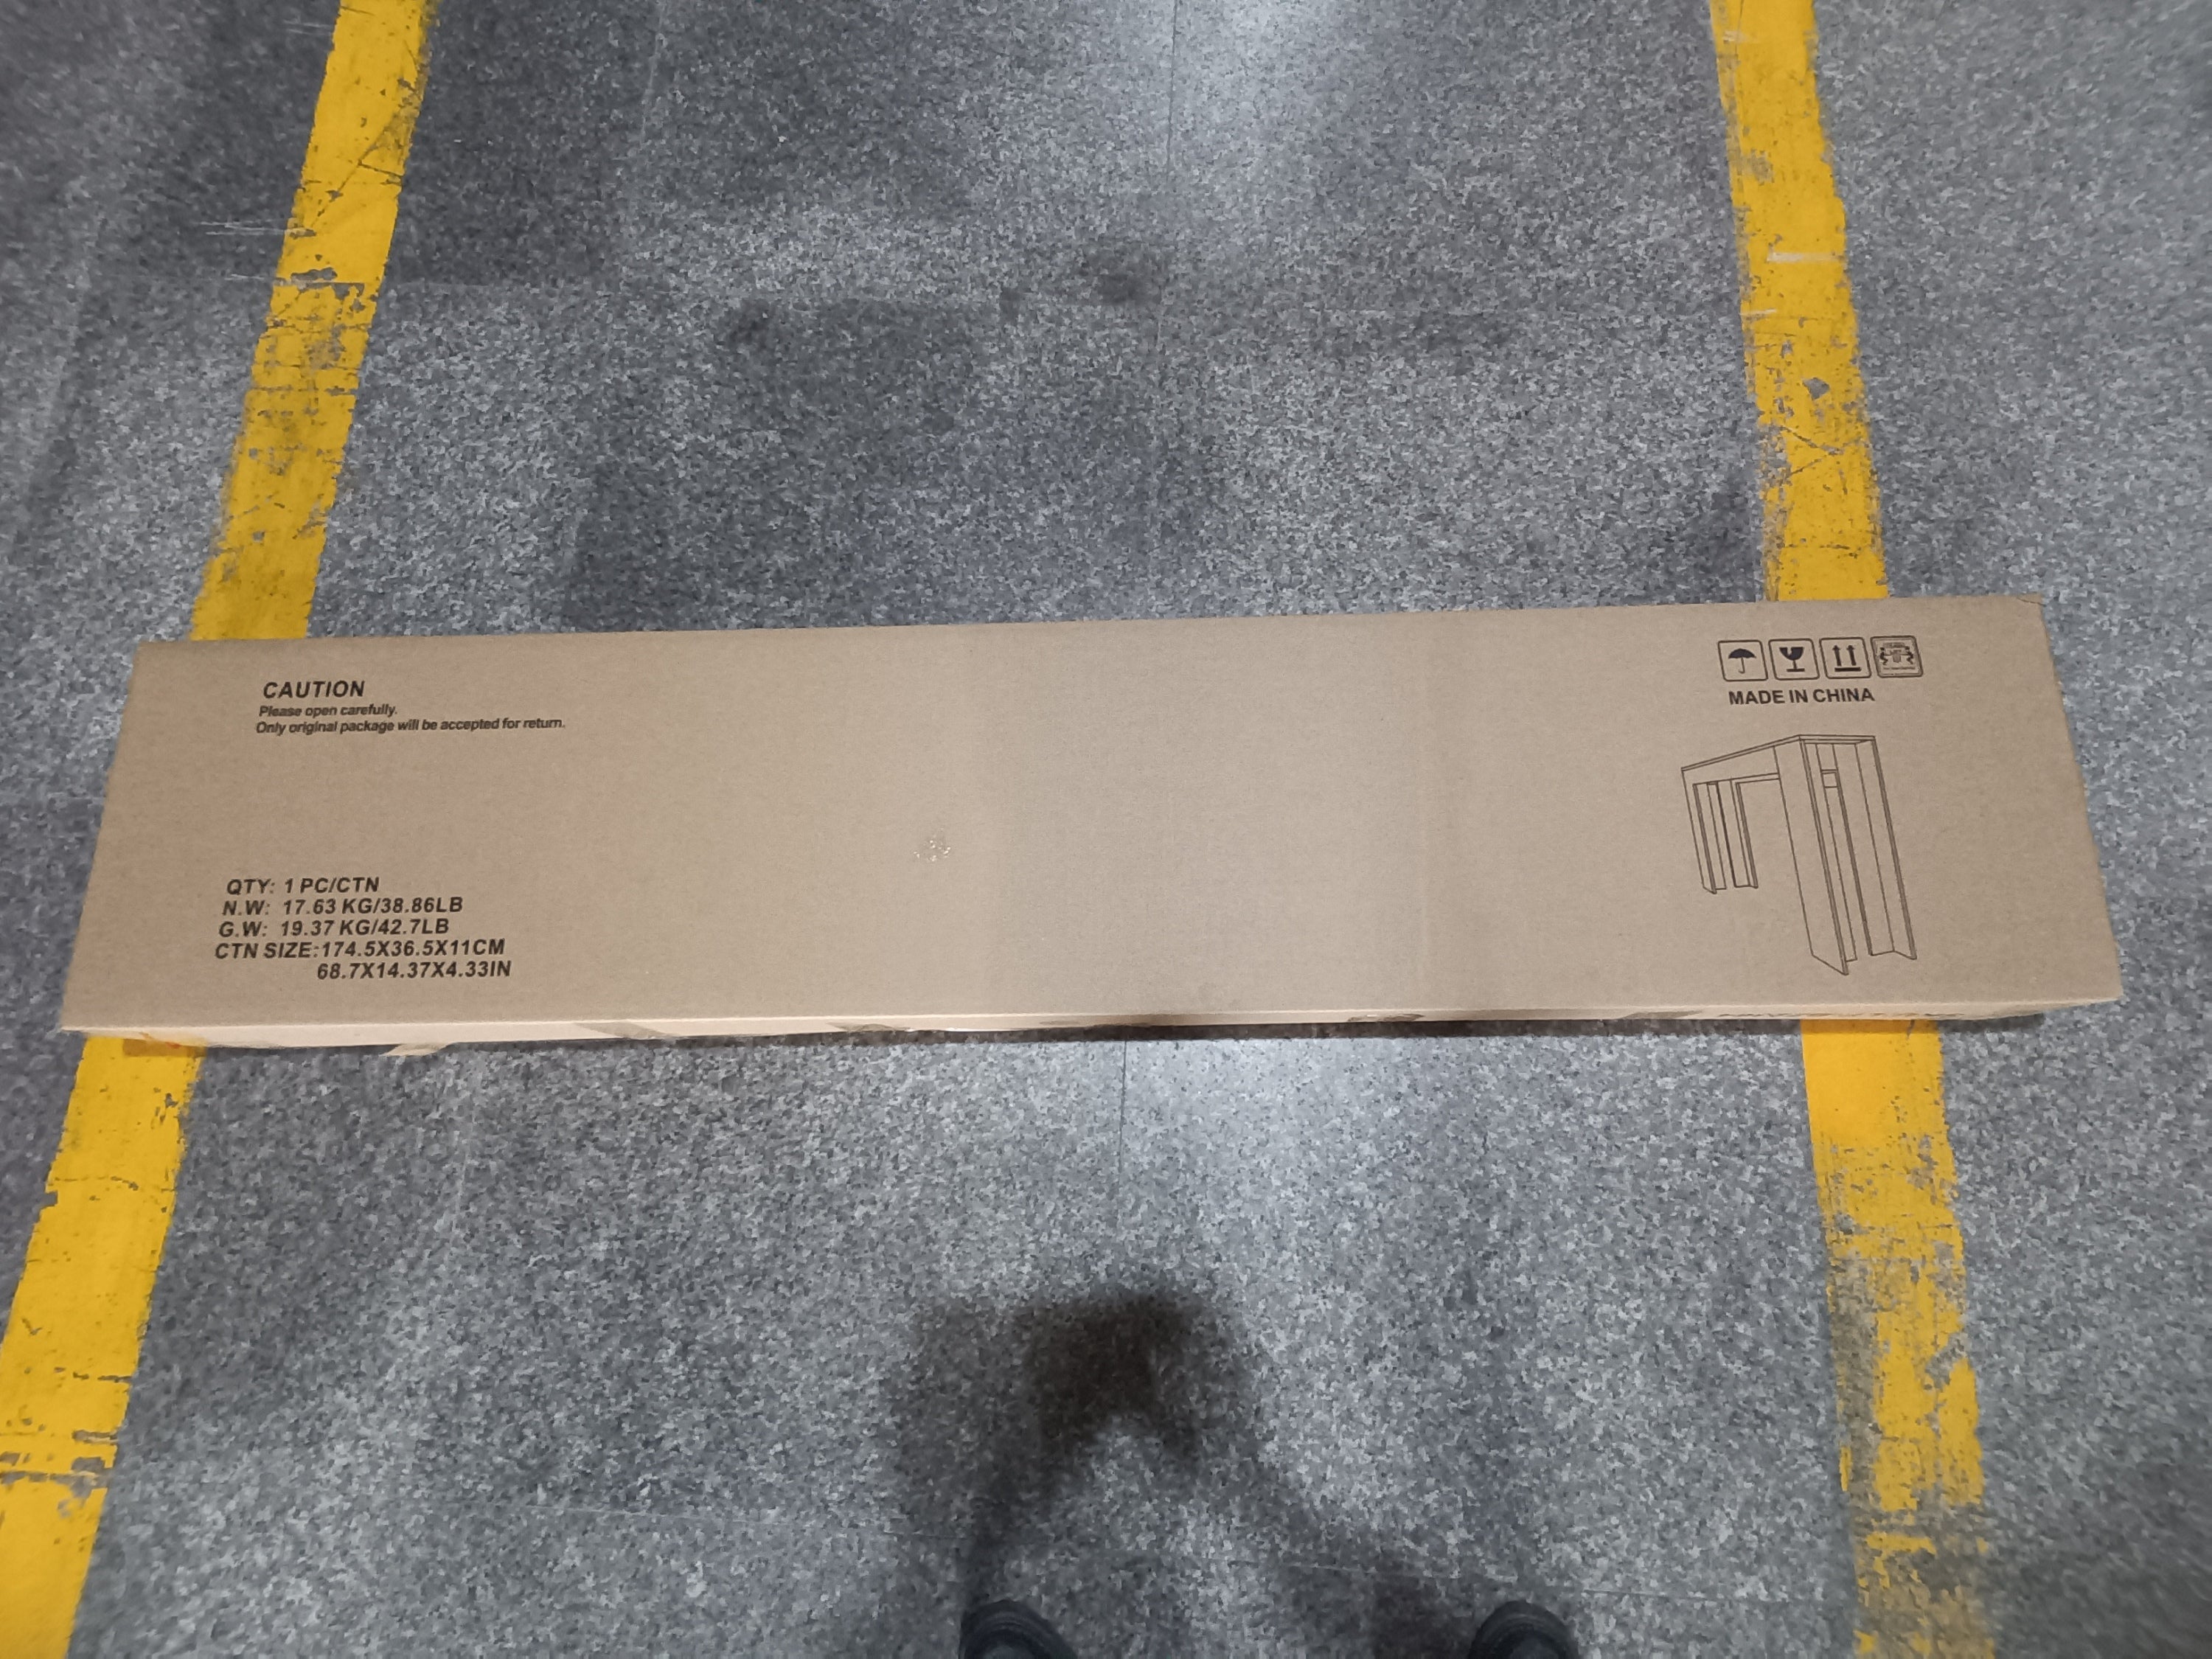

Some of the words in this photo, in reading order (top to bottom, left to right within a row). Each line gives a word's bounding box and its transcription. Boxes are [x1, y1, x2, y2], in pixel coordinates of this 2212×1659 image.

[262, 681, 365, 699] CAUTION
[1728, 690, 1785, 705] MADE
[1789, 689, 1808, 703] IN
[1812, 687, 1875, 703] CHINA
[259, 705, 303, 717] Please
[305, 705, 338, 717] open
[341, 703, 397, 717] carefully.
[256, 722, 287, 735] Only
[289, 721, 338, 735] original
[340, 720, 395, 734] package
[397, 720, 420, 731] will
[422, 719, 437, 731] be
[440, 718, 500, 732] accepted
[502, 717, 521, 728] for
[523, 718, 565, 728] return.
[226, 878, 275, 896] QTY:
[285, 878, 293, 893] 1
[300, 877, 380, 894] PC/CTN
[221, 900, 271, 916] N.W:
[283, 899, 336, 915] 17.63
[341, 897, 463, 914] KG/38.86LB
[218, 921, 268, 937] G.W:
[281, 919, 334, 936] 19.37
[339, 918, 449, 936] KG/42.7LB
[215, 942, 258, 959] CTN
[317, 960, 511, 978] 68.7X14.37X4.33IN
